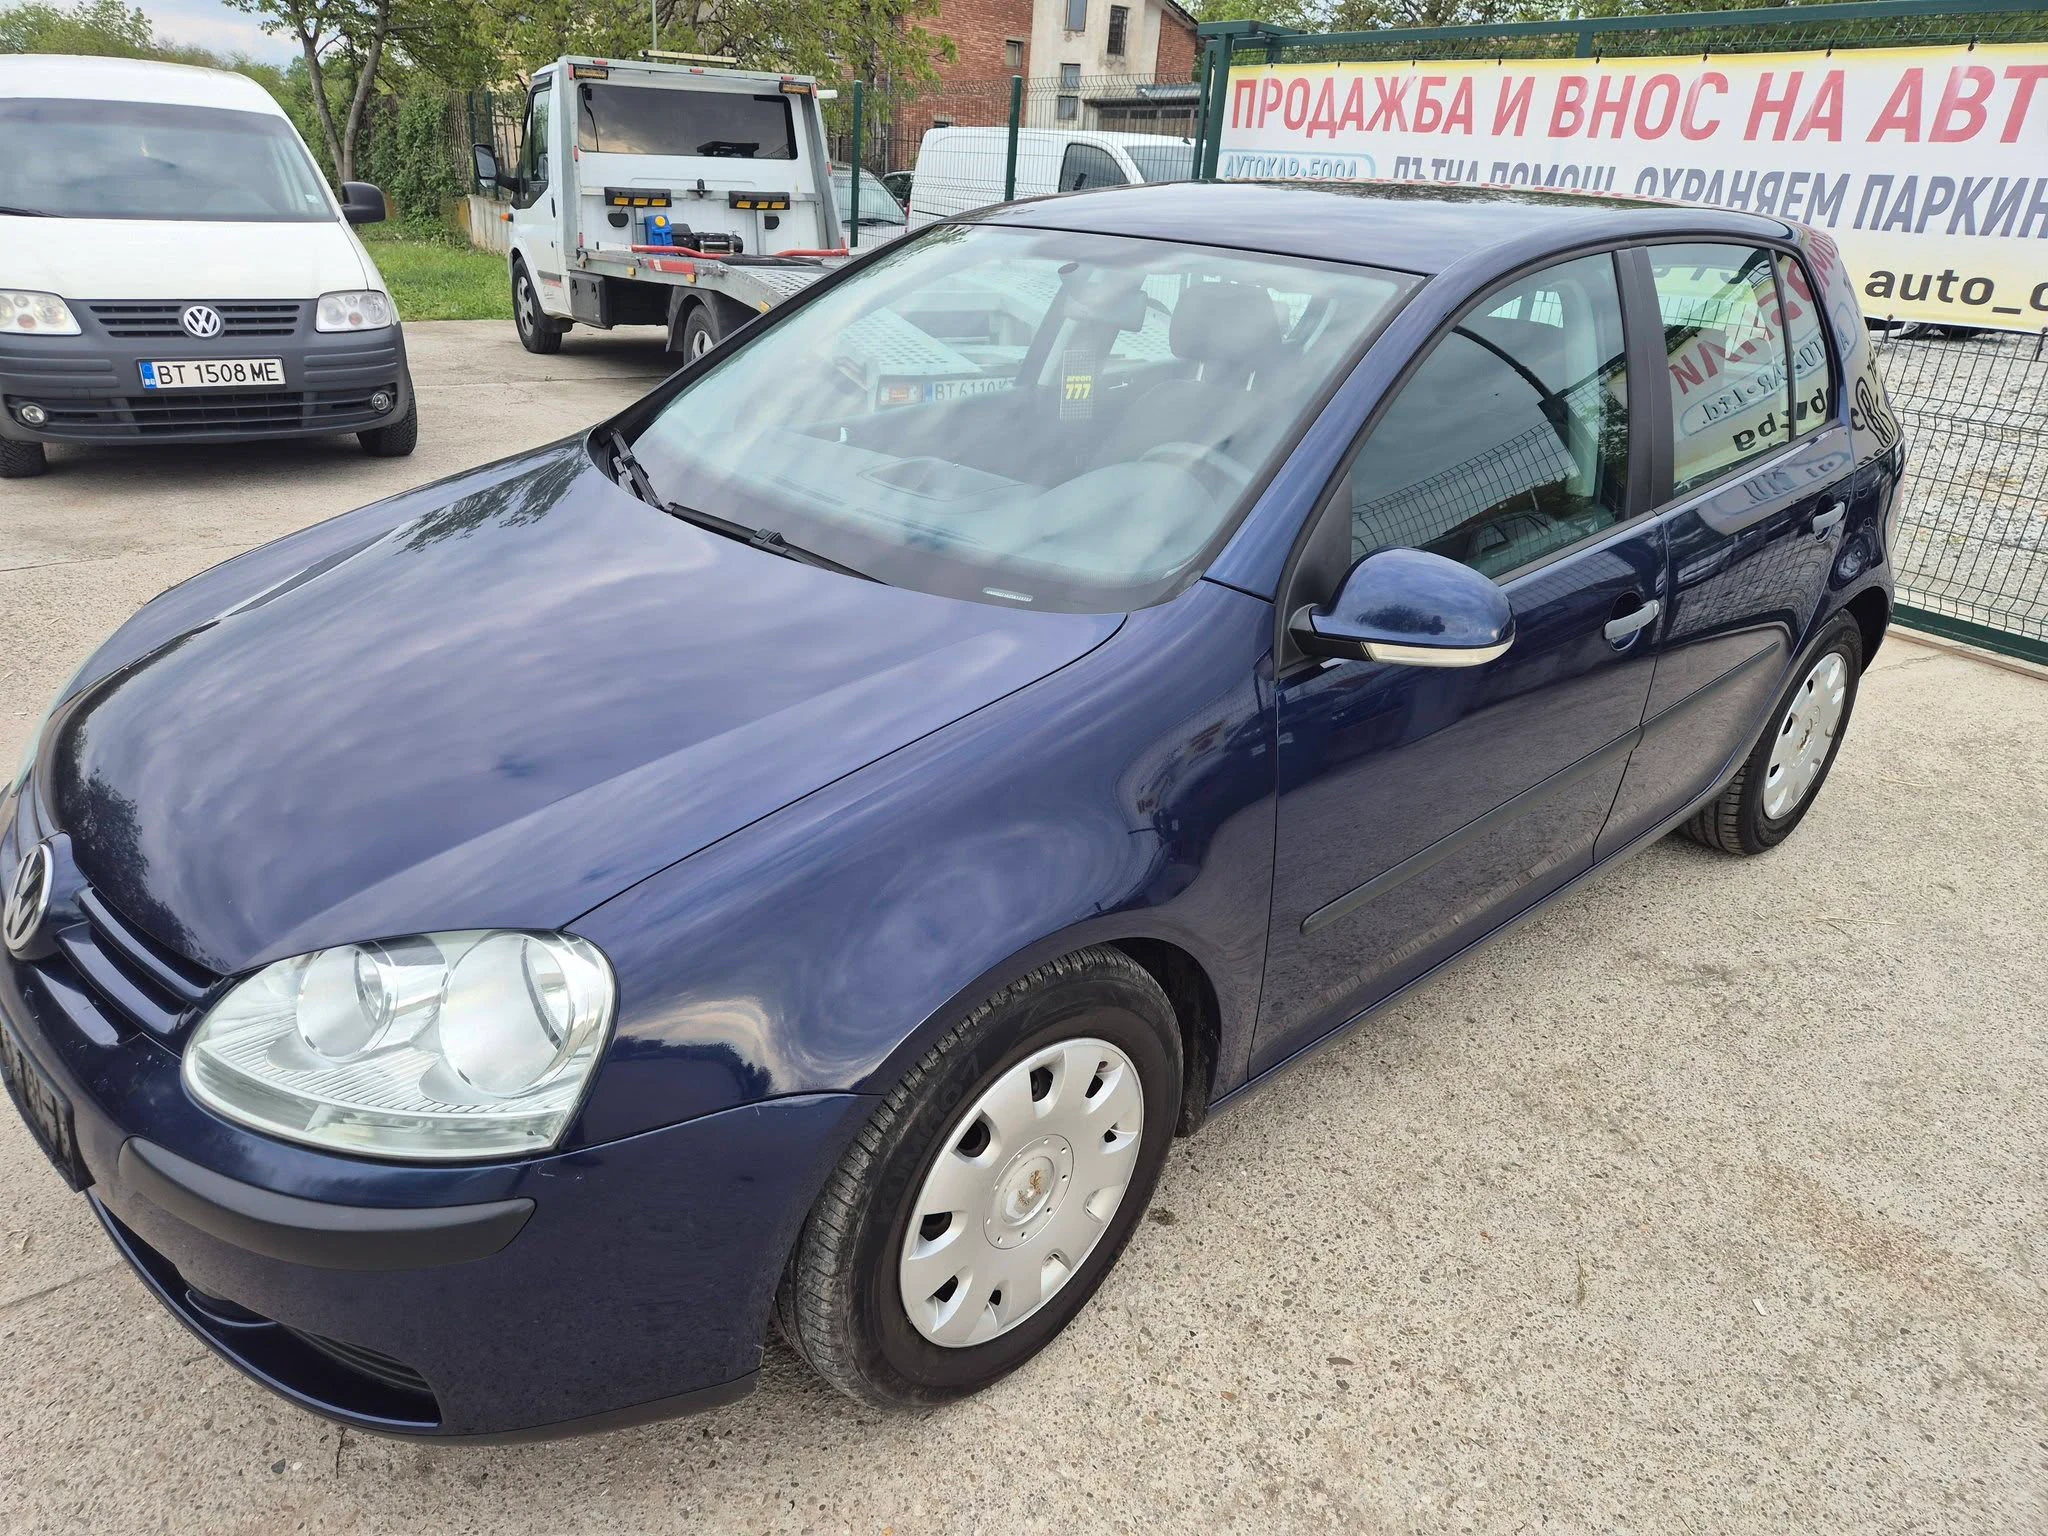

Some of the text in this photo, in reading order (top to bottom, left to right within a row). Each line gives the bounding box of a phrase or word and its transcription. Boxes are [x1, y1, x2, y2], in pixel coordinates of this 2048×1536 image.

[1231, 76, 1473, 139] ПРОДАЖБА
[1491, 76, 1536, 137] И
[1547, 72, 1729, 140] ВНОС
[1743, 70, 1845, 142] НА
[157, 362, 279, 385] BT 1508 ME
[935, 383, 955, 401] BT
[1065, 383, 1092, 400] 777
